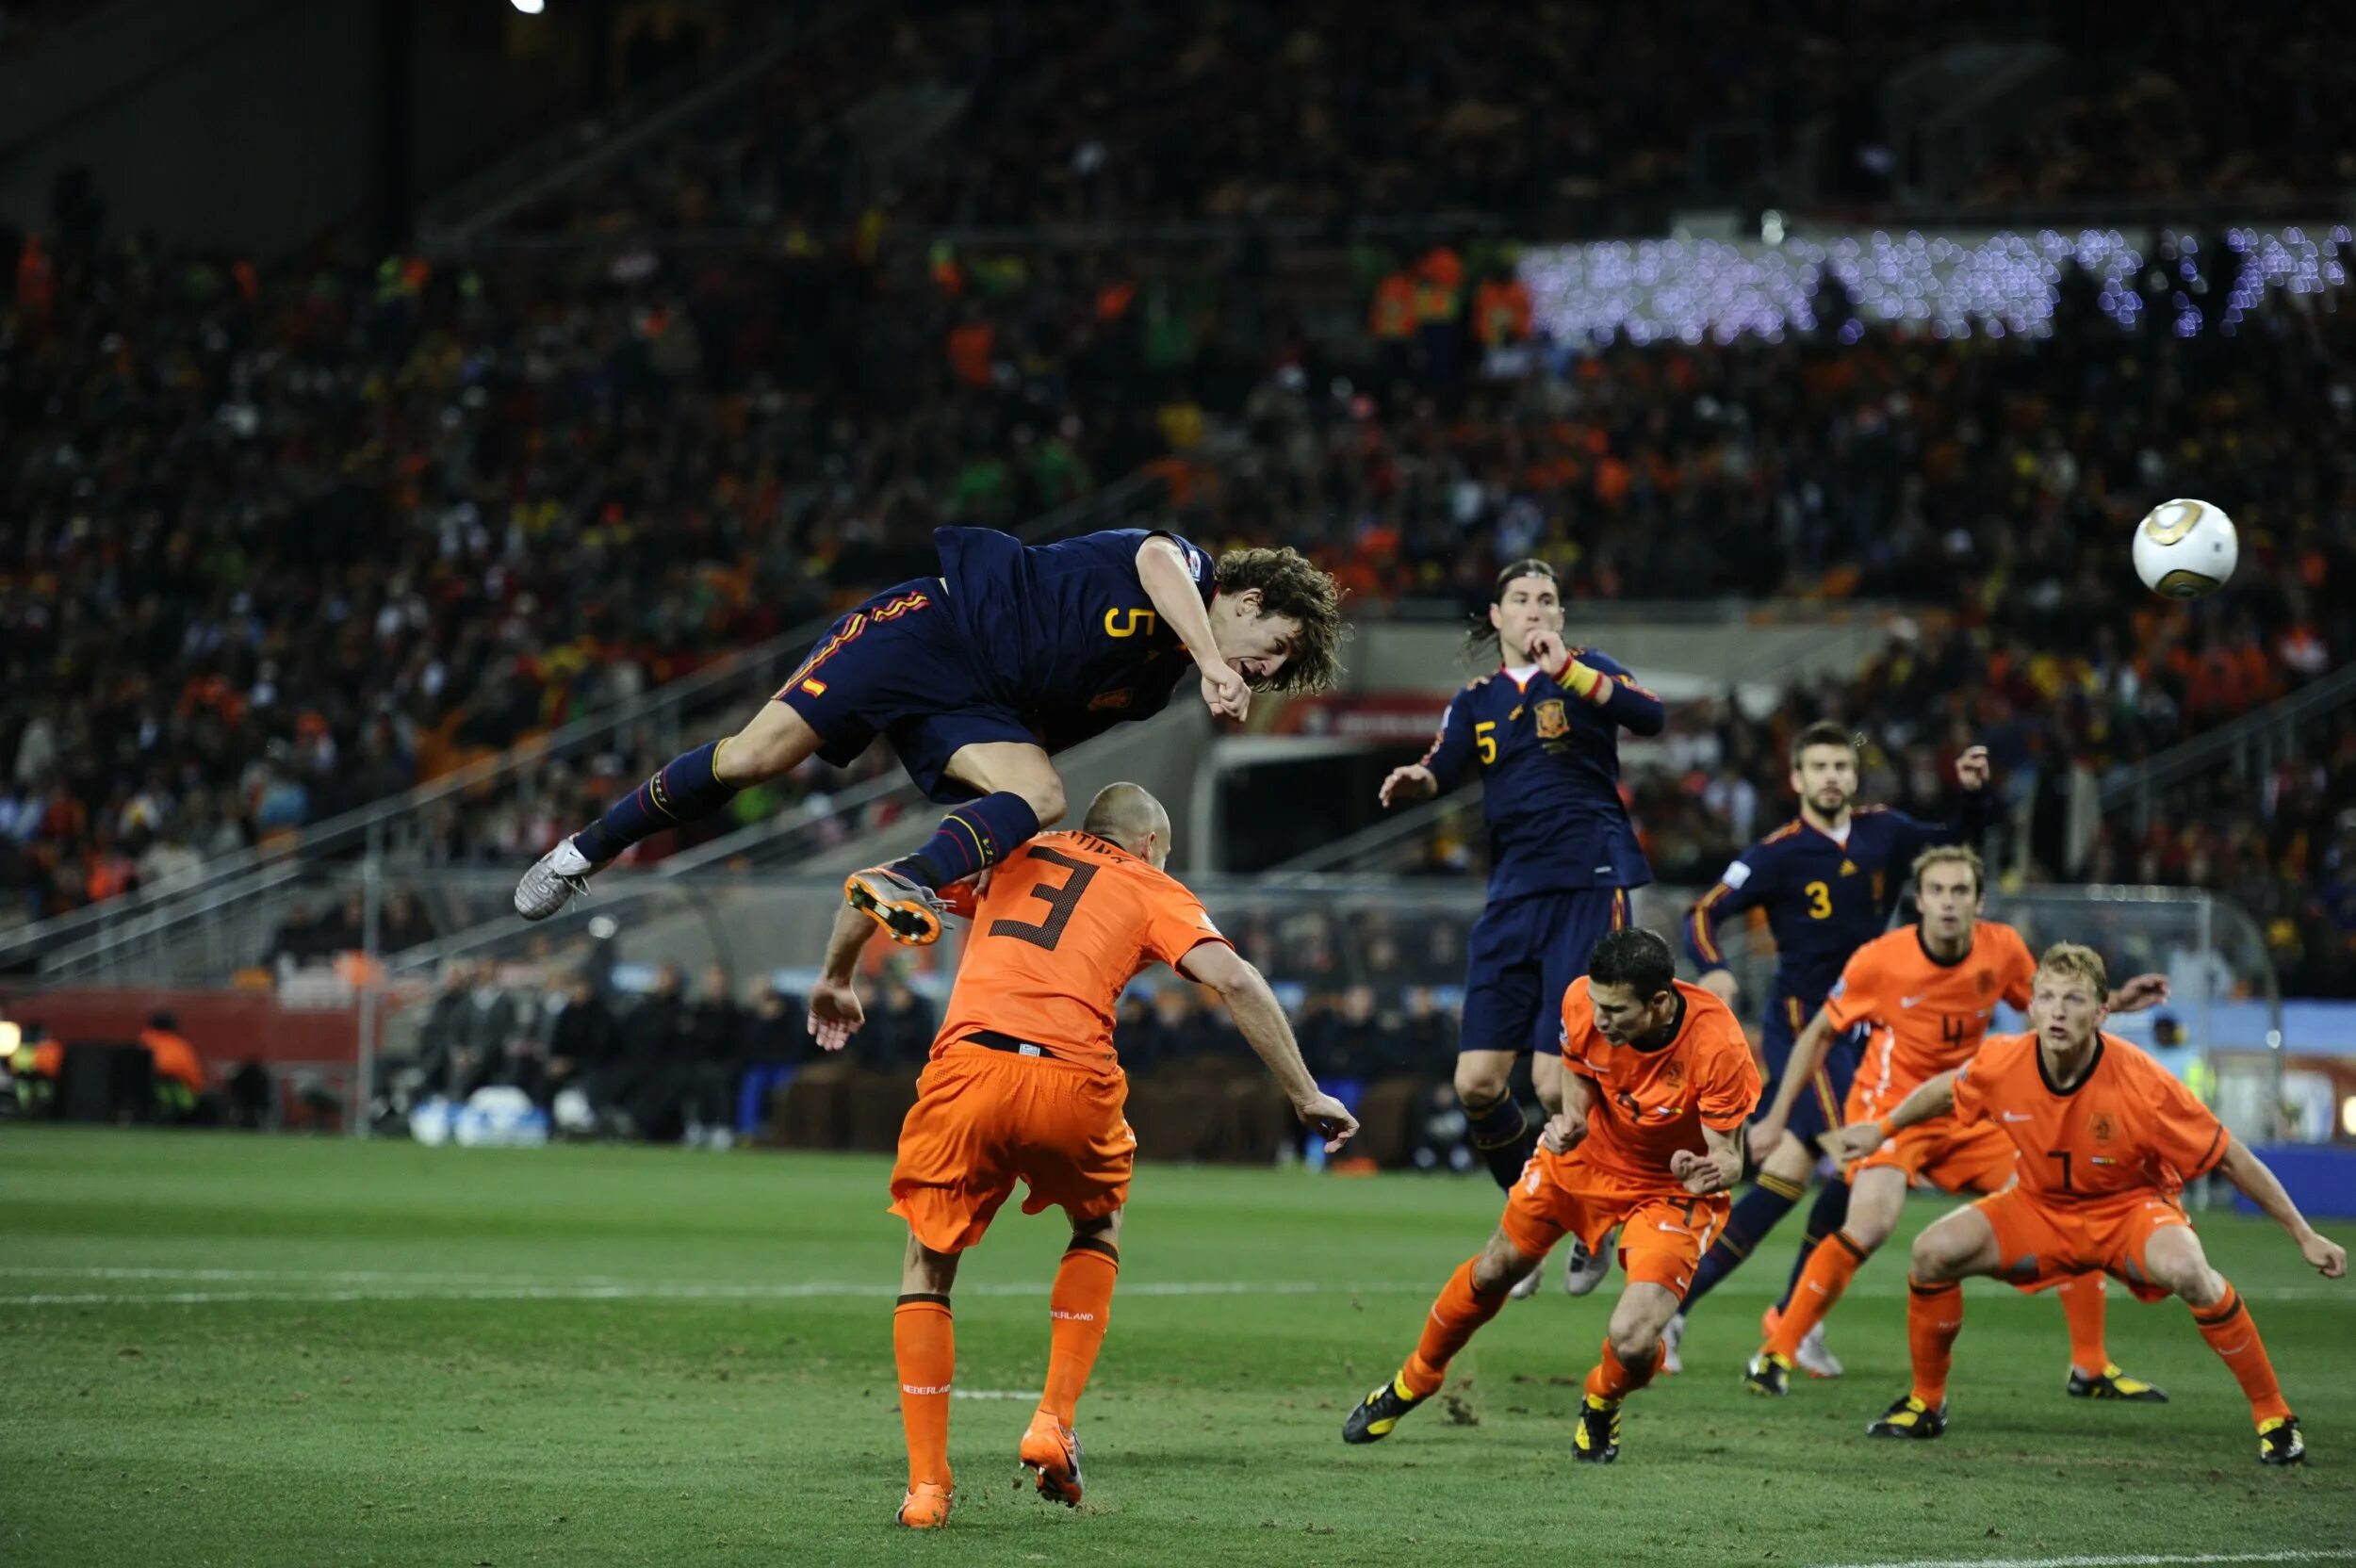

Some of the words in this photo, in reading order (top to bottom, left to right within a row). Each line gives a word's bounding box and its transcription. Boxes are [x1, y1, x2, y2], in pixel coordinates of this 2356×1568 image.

[1104, 608, 1155, 638] 5
[1475, 721, 1497, 764] 5
[988, 845, 1101, 951] 3
[1804, 880, 1833, 920] 3
[1942, 1012, 1964, 1050] 4
[2047, 1150, 2073, 1191] 7
